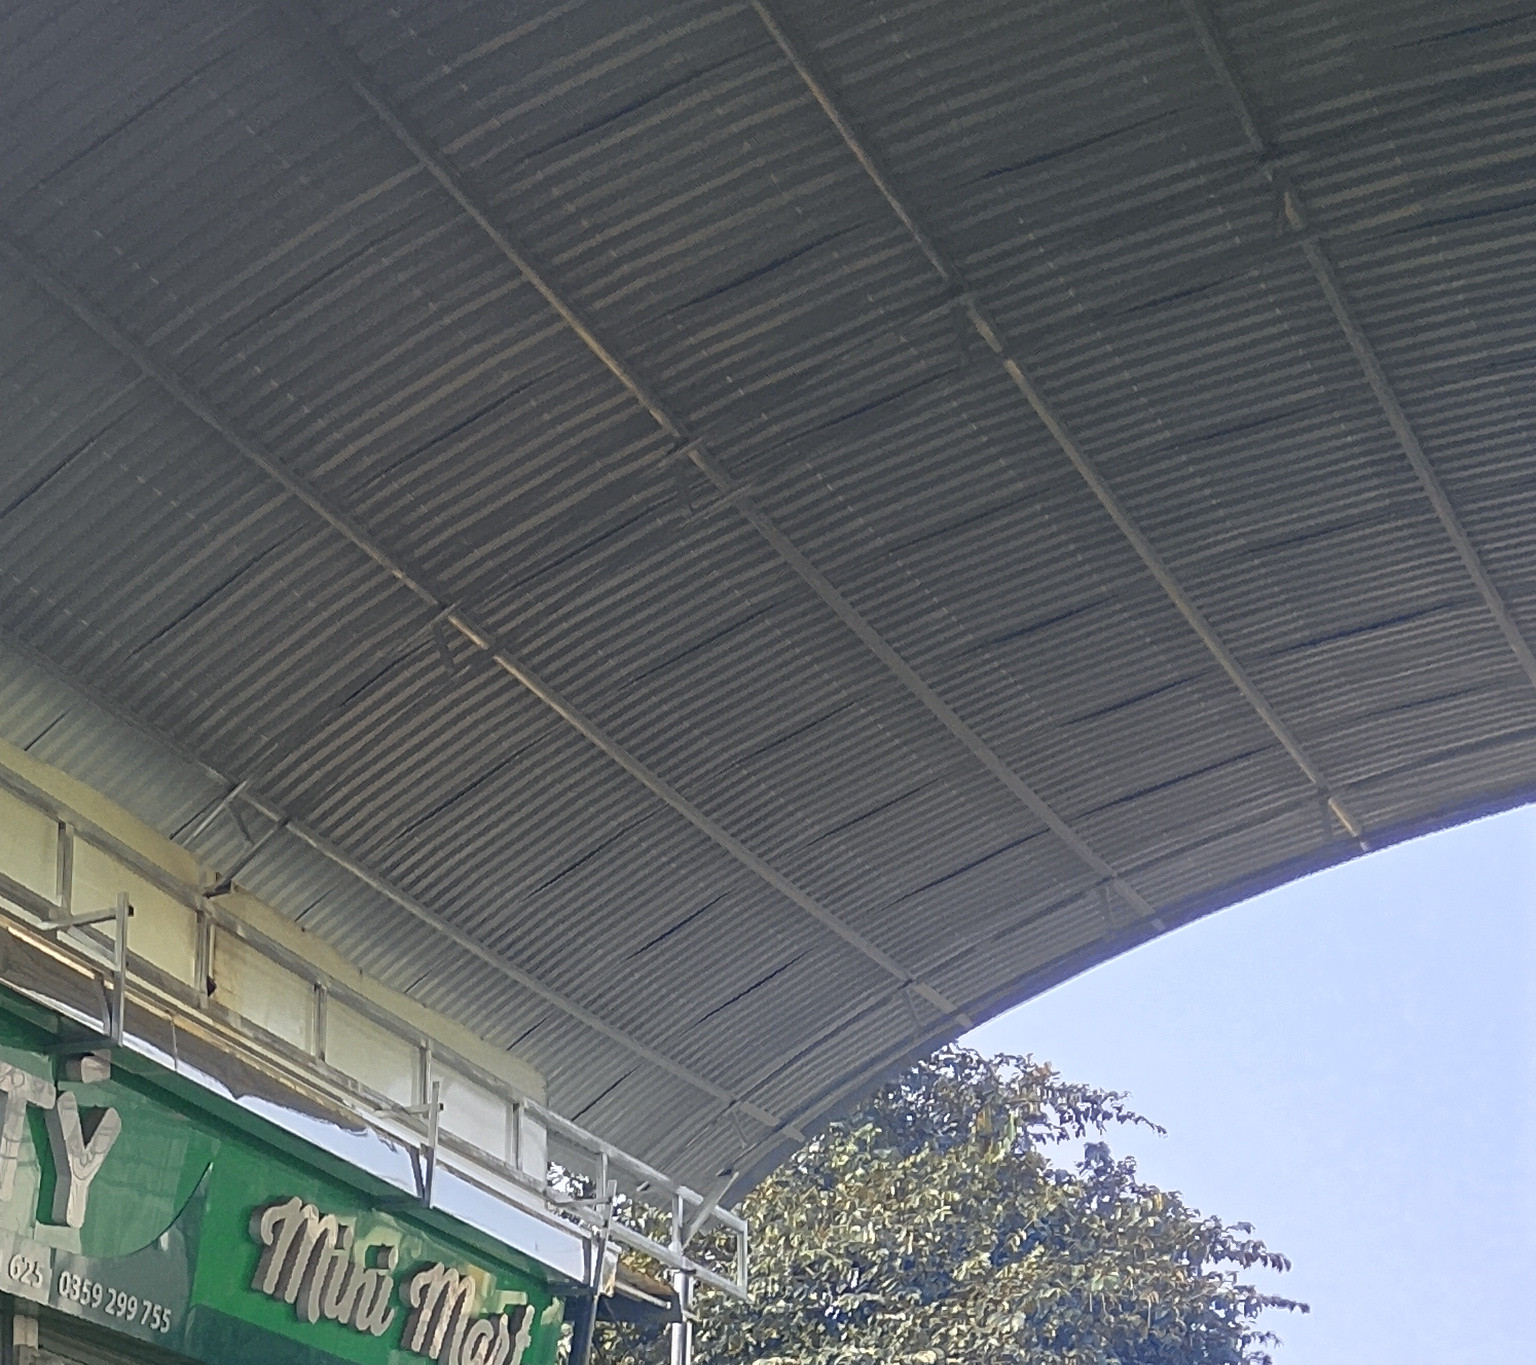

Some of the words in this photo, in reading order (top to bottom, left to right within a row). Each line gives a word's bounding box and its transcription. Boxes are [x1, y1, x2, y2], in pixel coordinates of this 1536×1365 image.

[7, 1253, 44, 1289] 625
[58, 1270, 103, 1311] 0359
[105, 1287, 140, 1326] 299
[140, 1299, 172, 1335] 755
[256, 1195, 396, 1338] Mini
